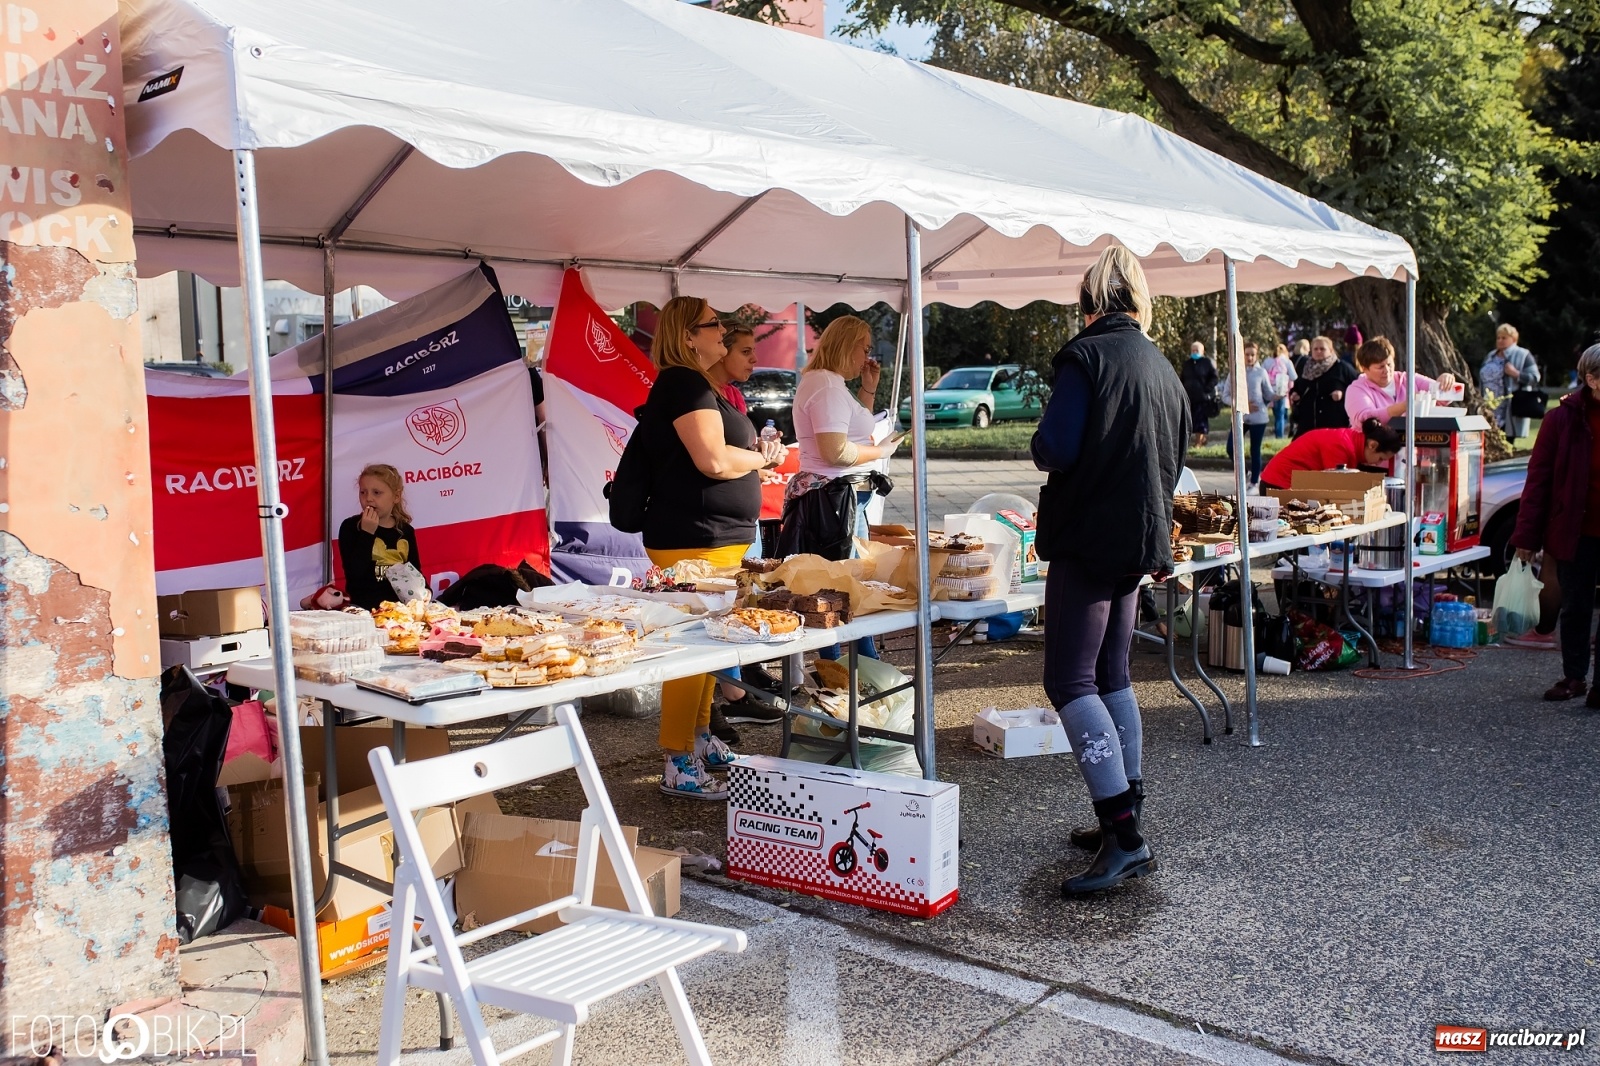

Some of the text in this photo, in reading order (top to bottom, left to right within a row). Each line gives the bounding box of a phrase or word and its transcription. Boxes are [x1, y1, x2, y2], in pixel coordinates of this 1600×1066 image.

[0, 3, 39, 44] P
[0, 53, 108, 100] DAŻ
[143, 74, 179, 95] NAMIX
[384, 330, 460, 376] RACIBÓRZ
[422, 363, 436, 375] 1217
[165, 457, 306, 495] RACIBRZ
[404, 461, 482, 483] RACIBÓRZ
[440, 489, 454, 497] 1217
[739, 818, 818, 841] RACING TEAM
[329, 931, 390, 960] WWW.OSKROB
